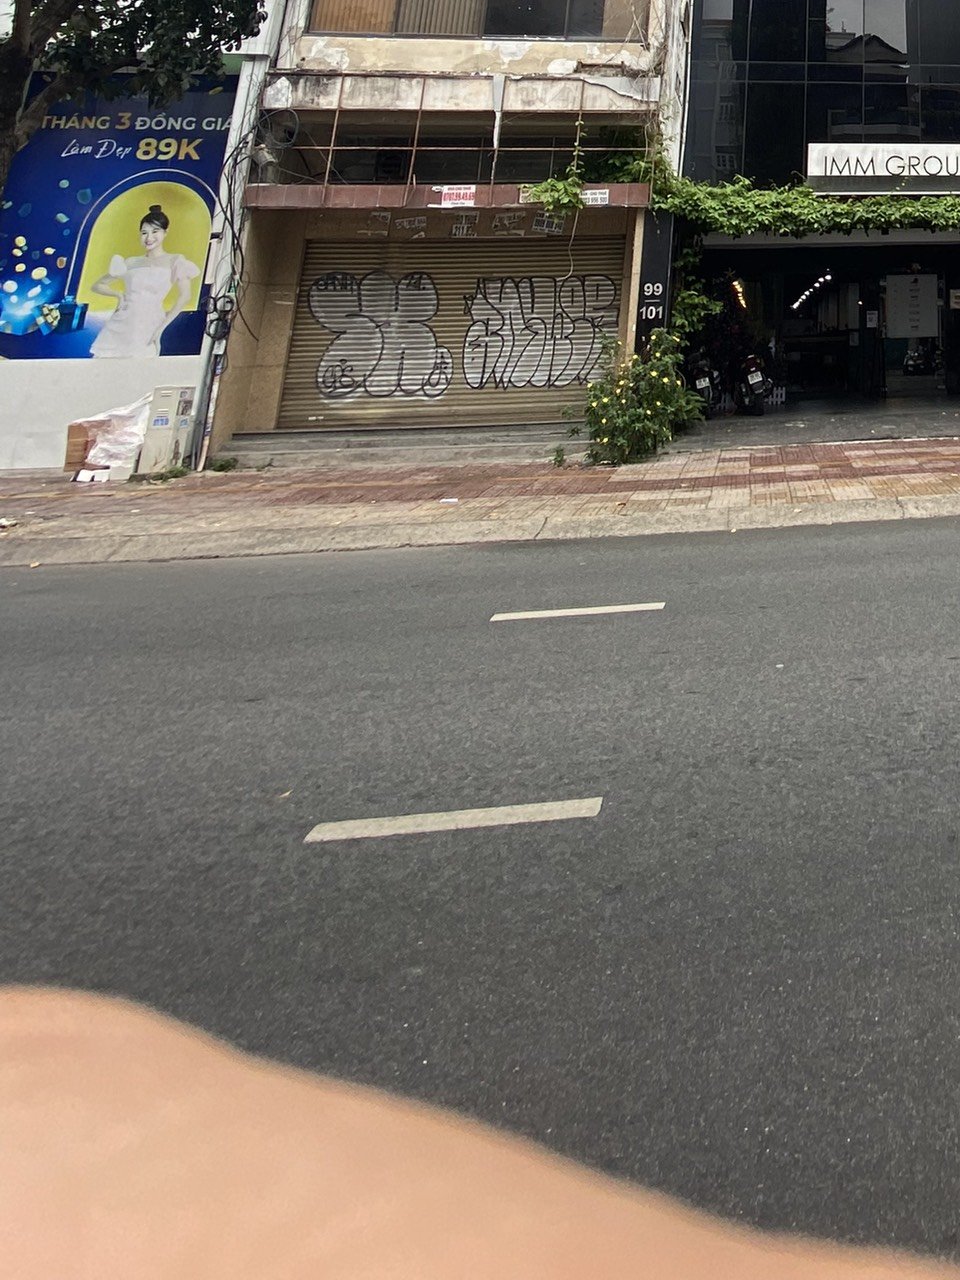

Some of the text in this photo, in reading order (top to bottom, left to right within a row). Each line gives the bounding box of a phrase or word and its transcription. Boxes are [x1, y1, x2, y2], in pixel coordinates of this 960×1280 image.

[41, 113, 111, 130] THÁNG
[115, 112, 132, 130] 3
[135, 113, 196, 131] ĐỒNG
[61, 137, 203, 161] Làm Đẹp 89K
[824, 155, 876, 177] IMM
[644, 283, 663, 296] 99
[640, 306, 663, 319] 101
